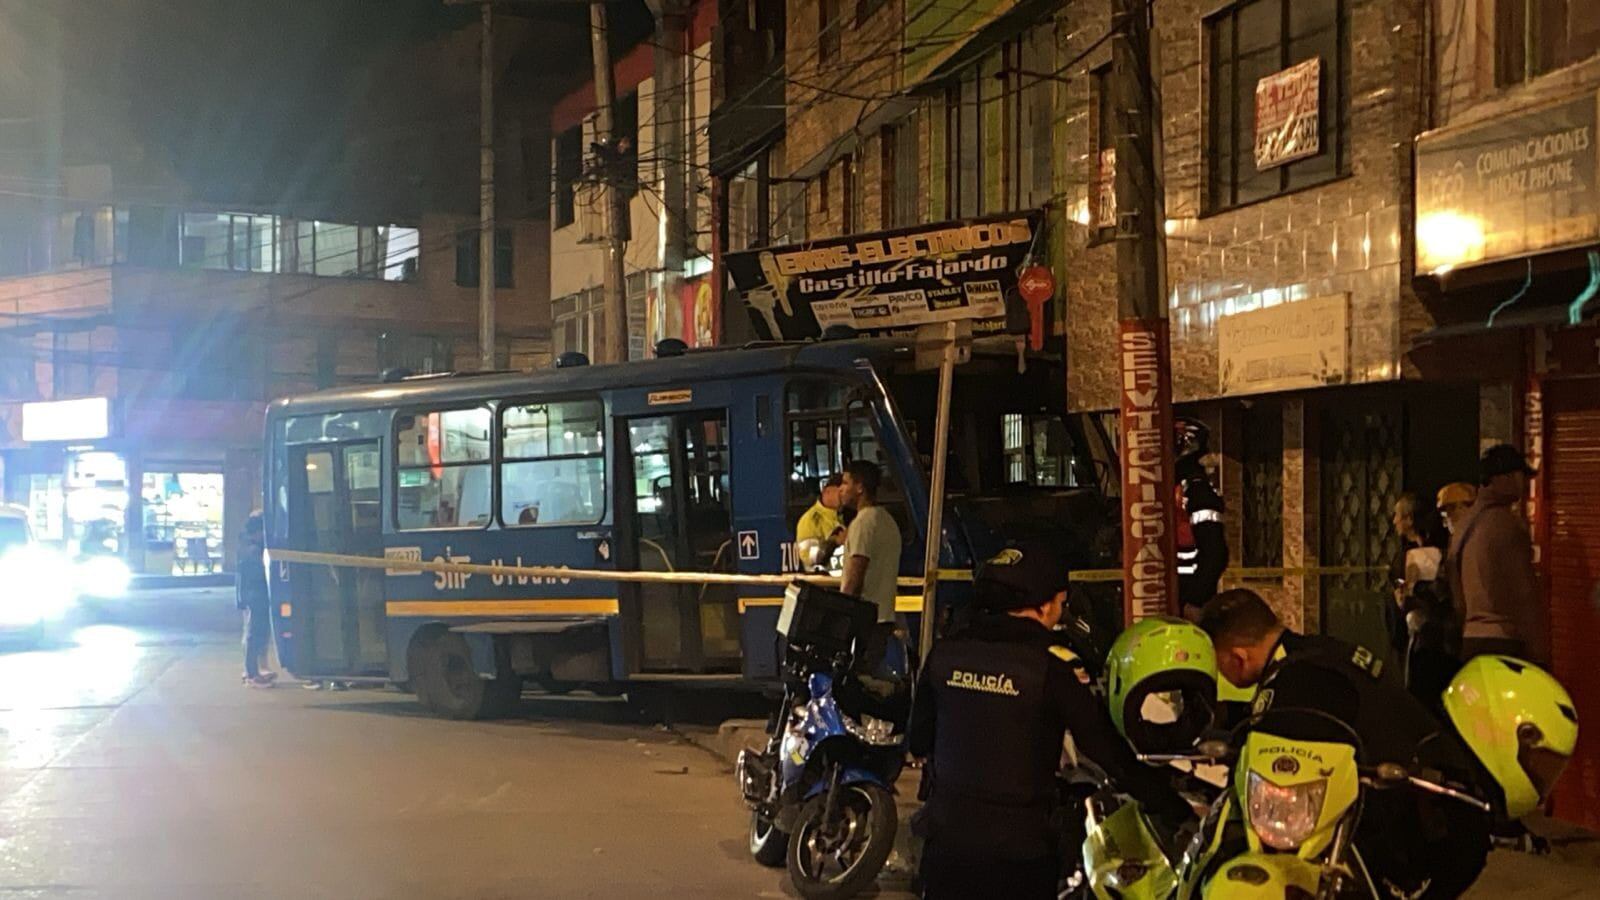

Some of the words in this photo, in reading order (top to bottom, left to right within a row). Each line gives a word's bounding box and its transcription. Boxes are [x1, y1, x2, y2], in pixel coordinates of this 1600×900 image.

[1476, 127, 1589, 175] COMUNICACIONES
[952, 669, 1015, 690] POLICÍA
[1258, 746, 1324, 764] POLICÍA
